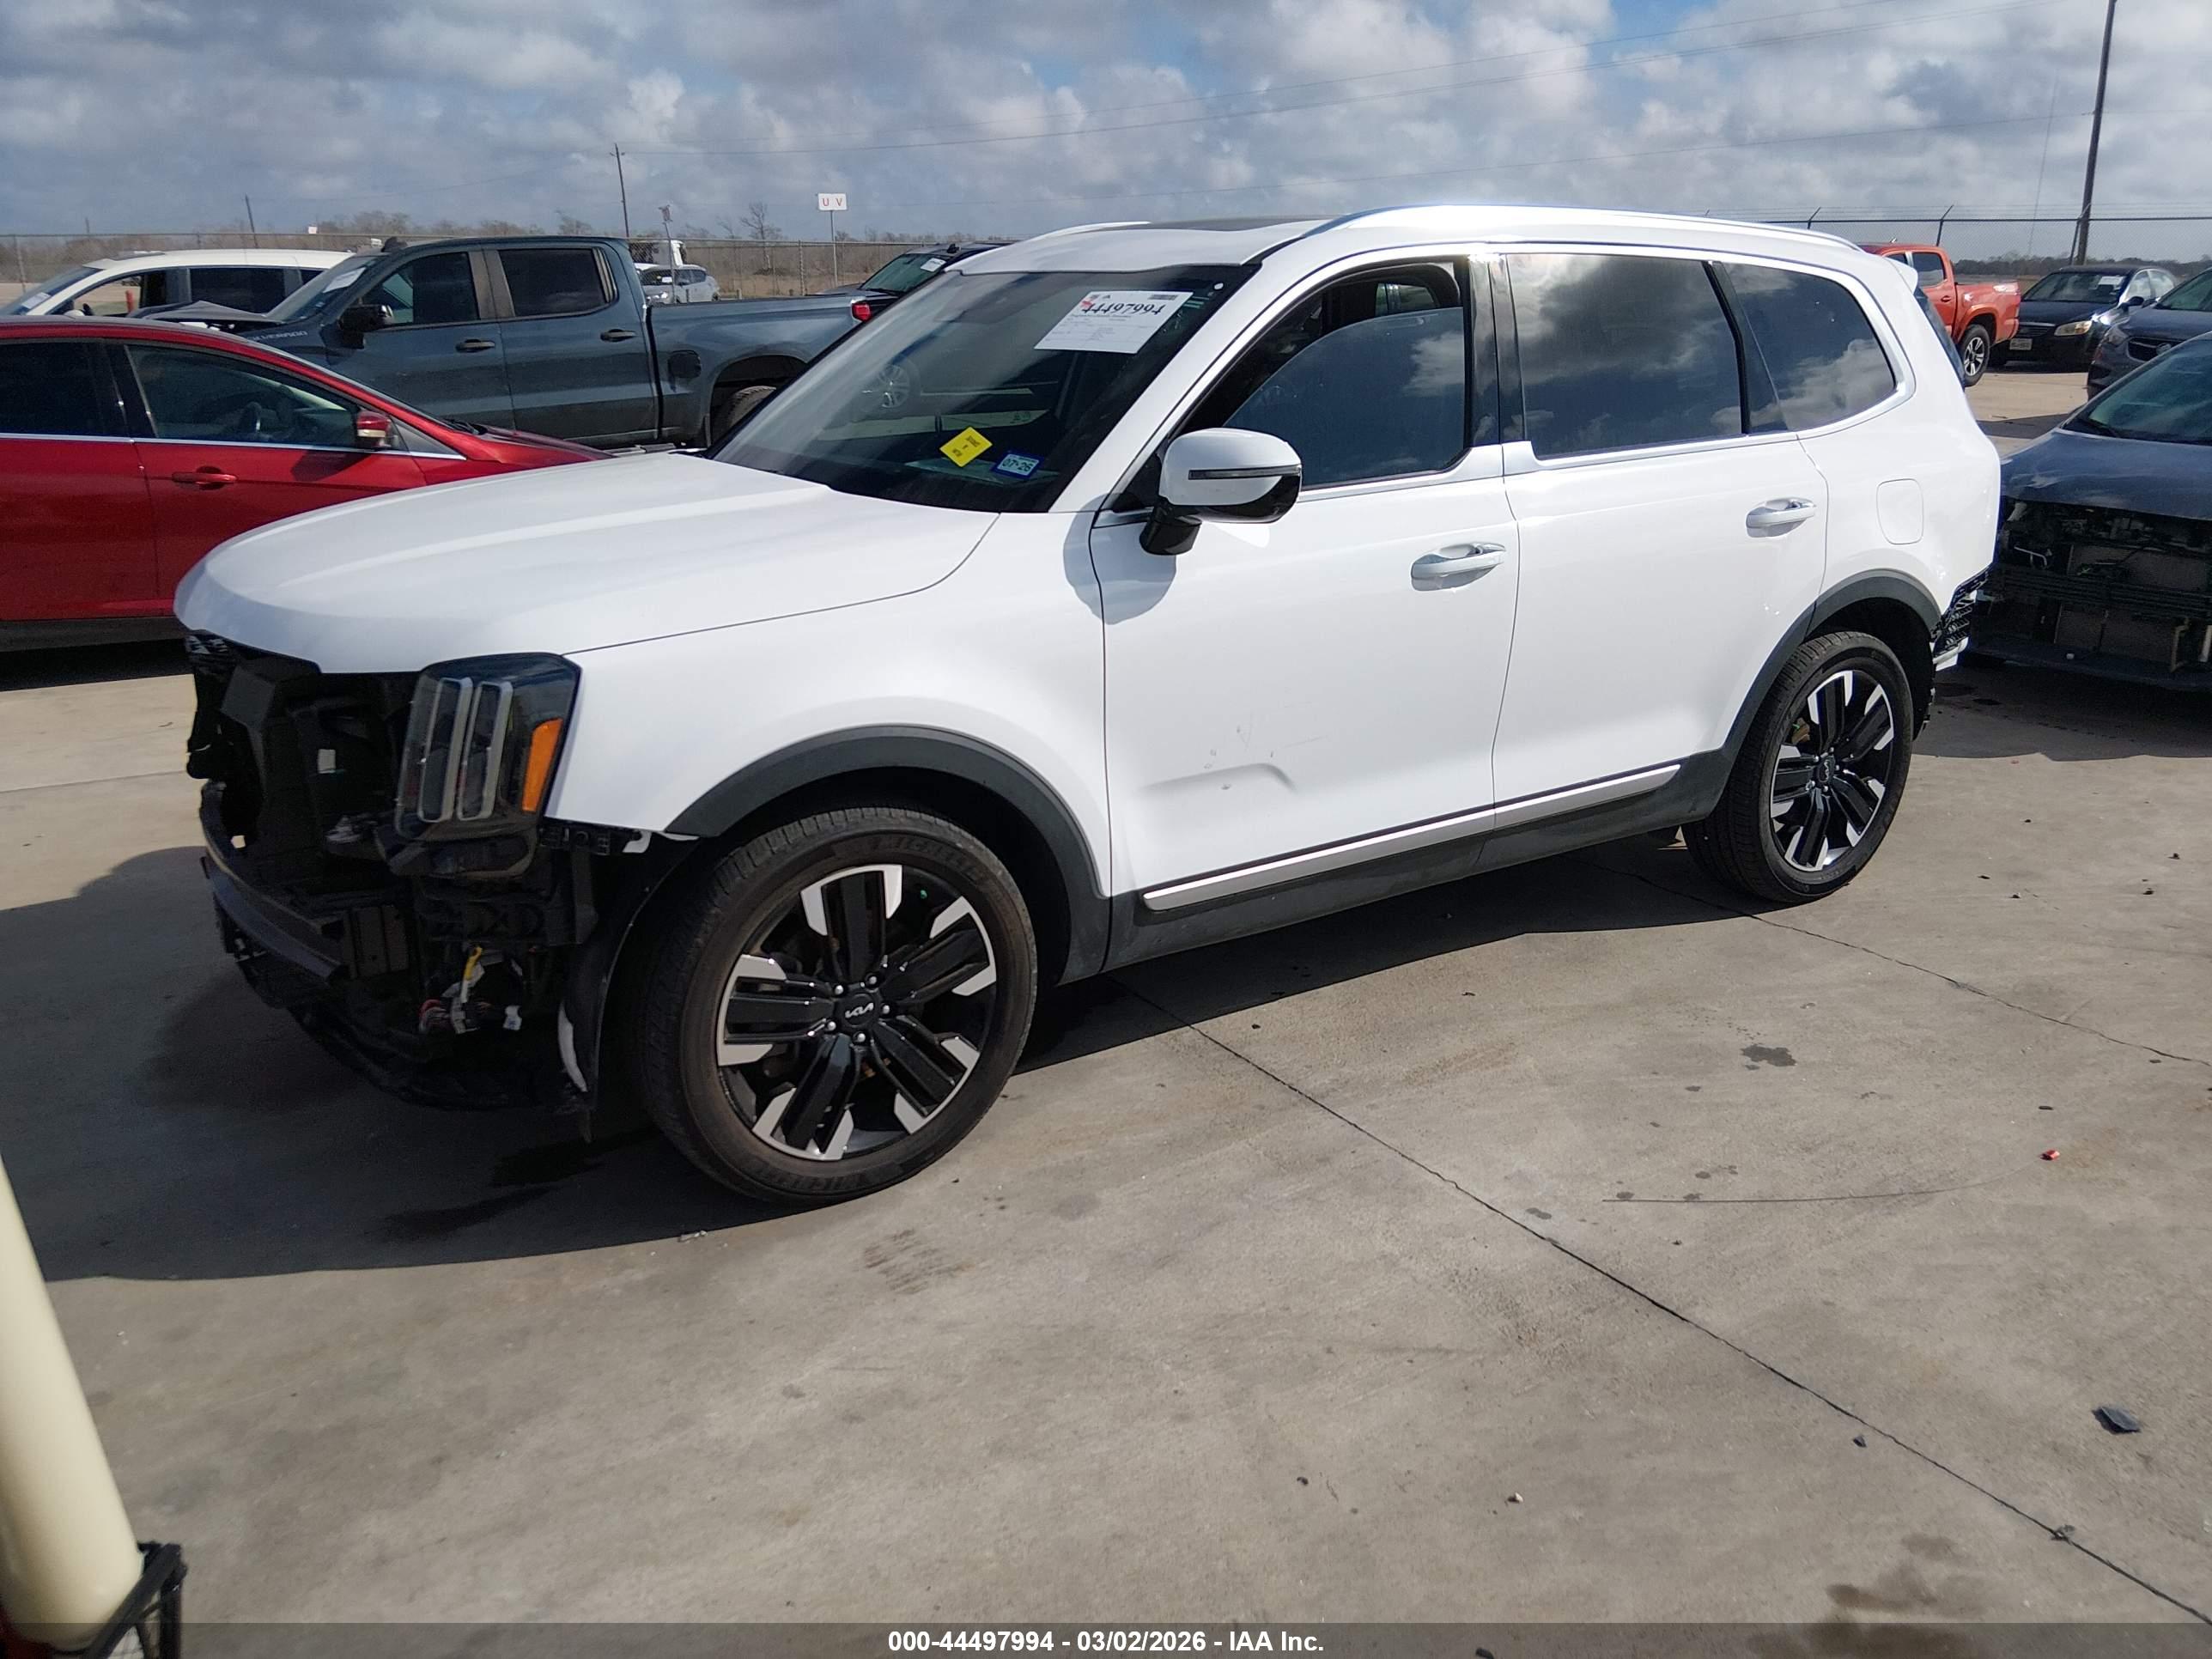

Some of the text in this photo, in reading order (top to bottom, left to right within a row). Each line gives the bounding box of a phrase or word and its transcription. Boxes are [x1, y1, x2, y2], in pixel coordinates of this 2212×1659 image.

[822, 198, 843, 207] U V
[1081, 302, 1165, 315] 44497994
